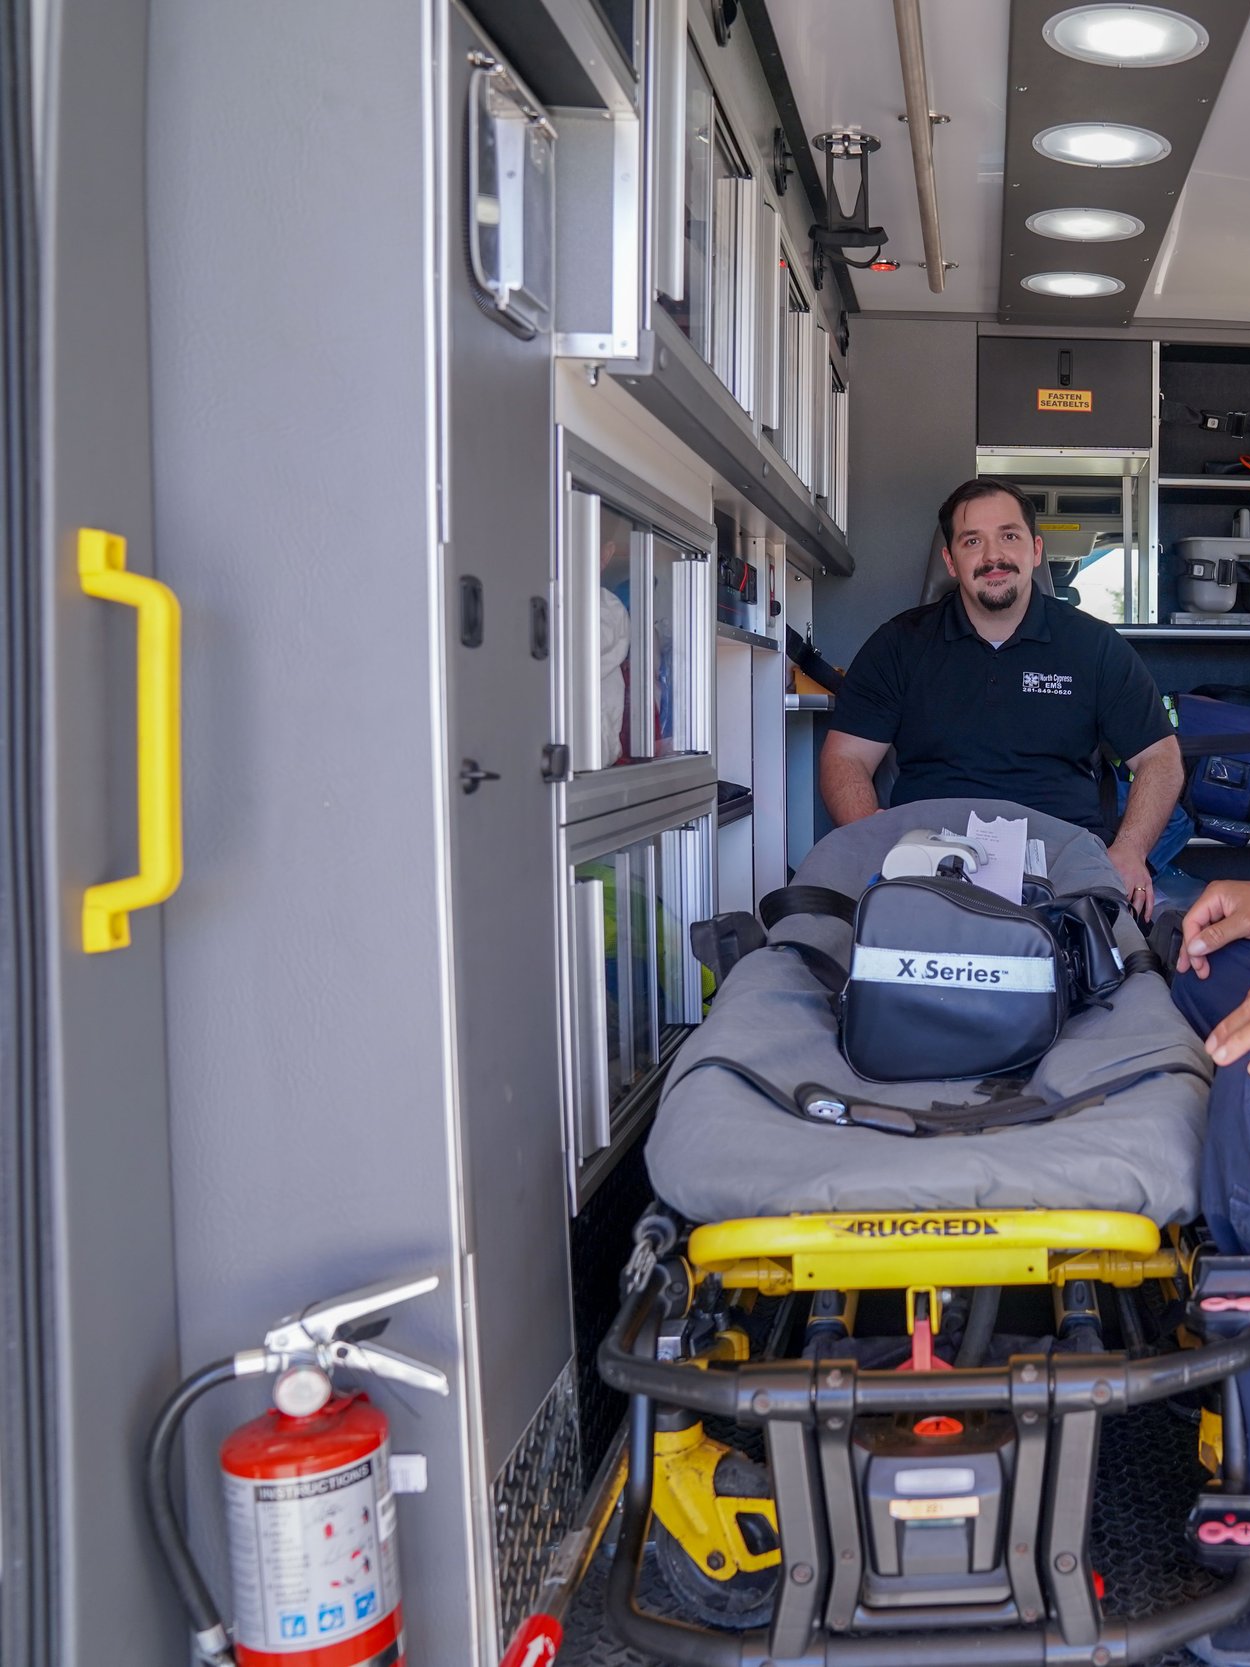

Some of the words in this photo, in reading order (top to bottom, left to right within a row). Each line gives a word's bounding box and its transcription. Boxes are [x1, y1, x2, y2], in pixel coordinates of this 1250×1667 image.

[1040, 399, 1090, 408] SEATBELTS
[1048, 393, 1082, 401] FASTEN
[856, 1219, 981, 1237] RUGGED
[258, 1464, 370, 1499] INSTRUCTIONS
